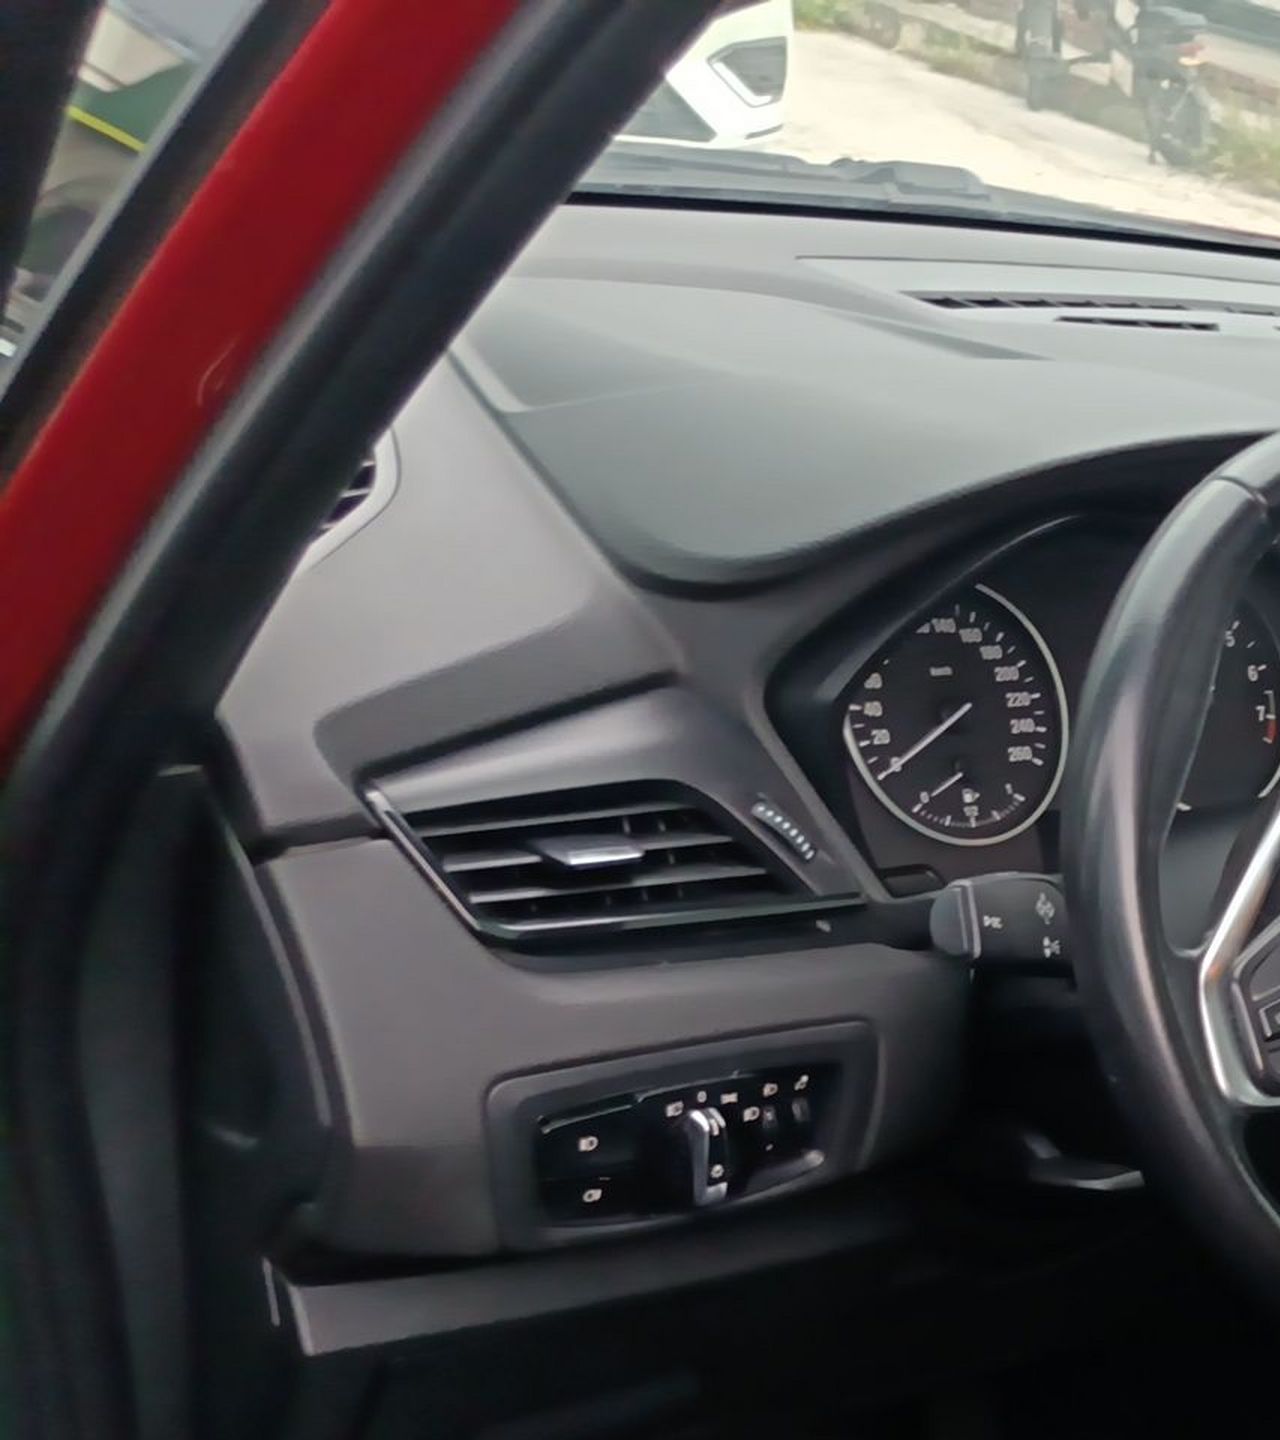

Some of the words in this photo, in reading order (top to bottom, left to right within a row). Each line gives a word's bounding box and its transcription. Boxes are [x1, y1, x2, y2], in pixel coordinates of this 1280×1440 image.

[1225, 630, 1235, 647] 5
[995, 666, 1019, 682] 200
[1247, 665, 1258, 681] 6
[1005, 692, 1031, 707] 220
[1256, 705, 1265, 721] 7
[1009, 718, 1035, 734] 240
[871, 729, 890, 745] 20
[1007, 746, 1033, 762] 260
